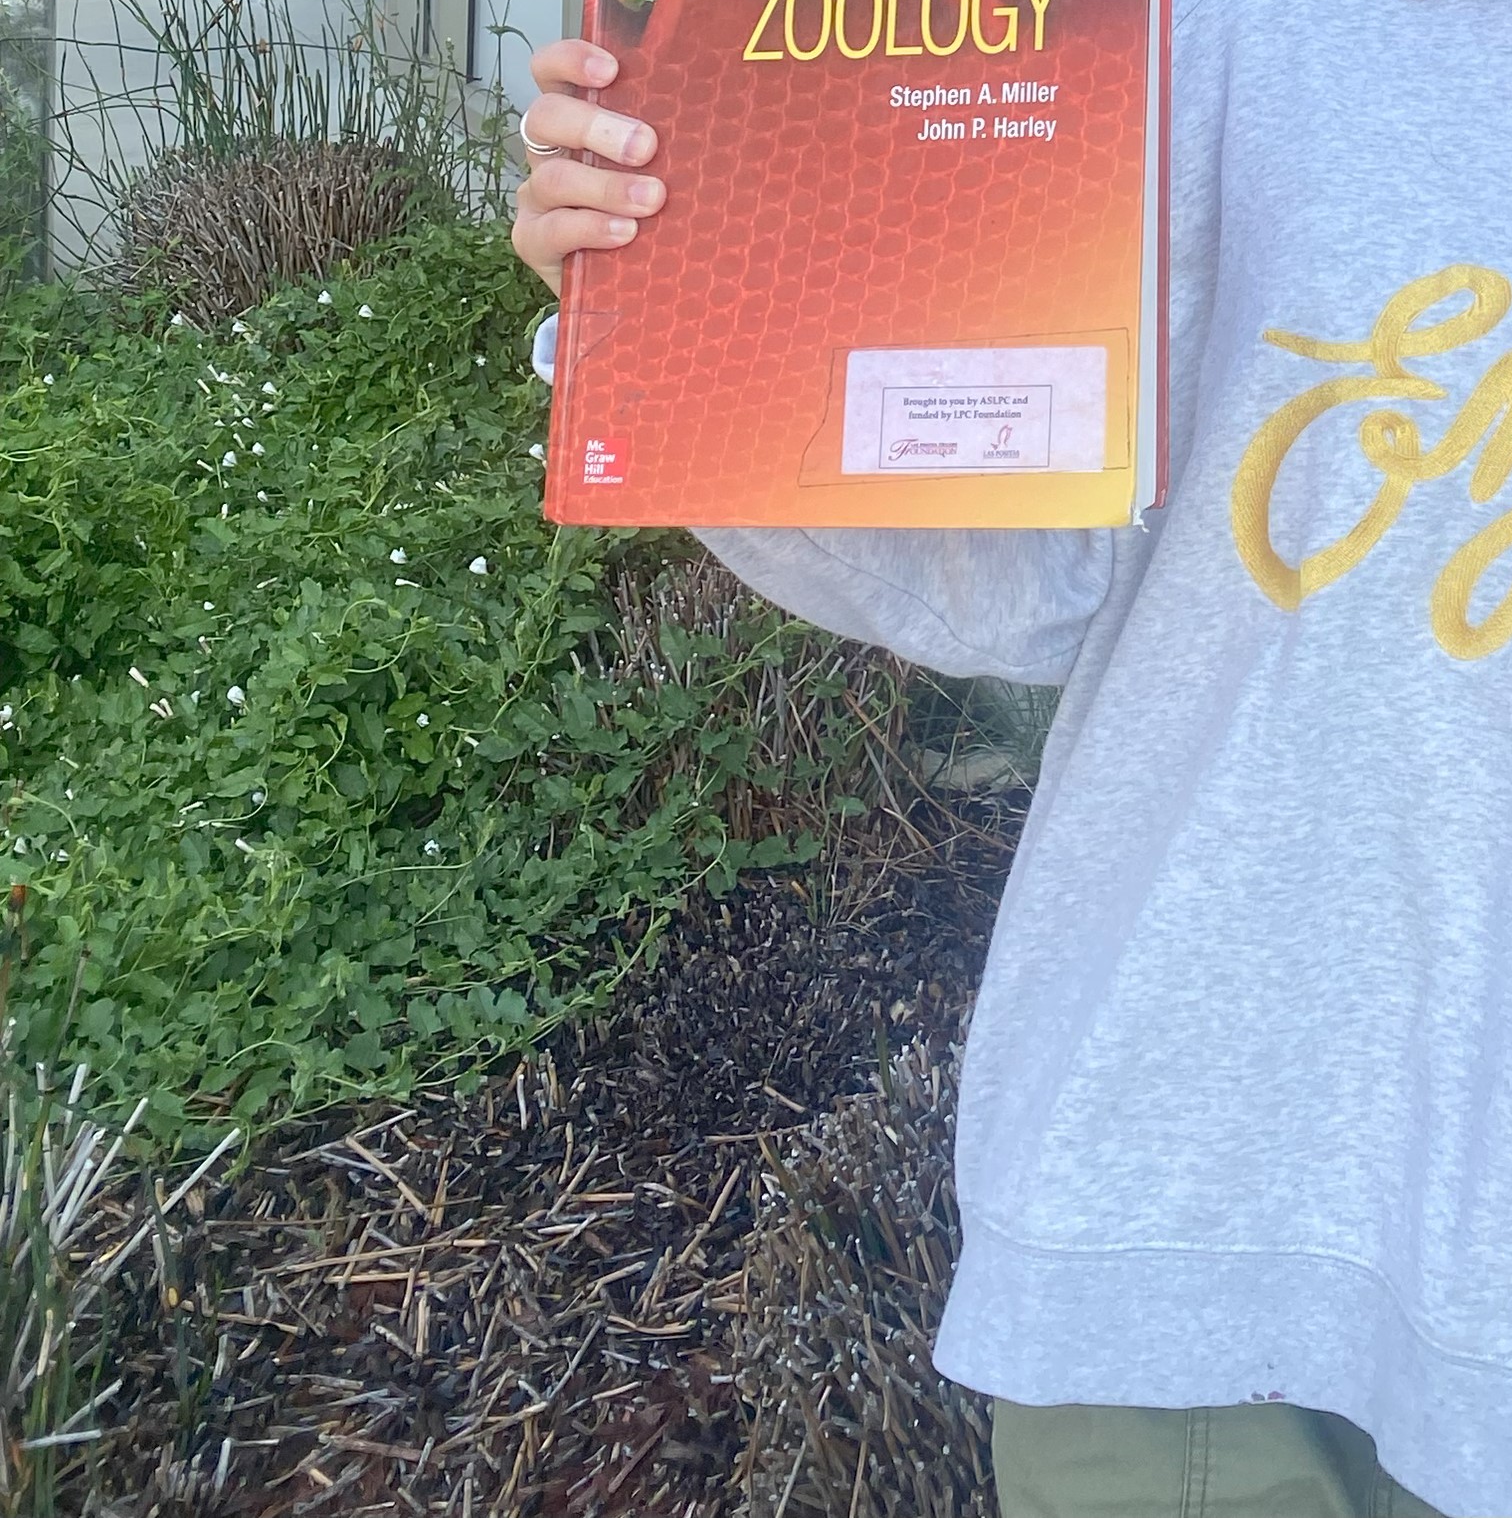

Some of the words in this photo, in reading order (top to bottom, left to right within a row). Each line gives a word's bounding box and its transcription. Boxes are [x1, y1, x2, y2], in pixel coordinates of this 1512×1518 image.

[889, 84, 971, 110] Stephen
[977, 83, 998, 105] A.
[1002, 81, 1059, 104] Miller
[917, 118, 965, 141] John
[971, 117, 987, 139] P.
[993, 115, 1057, 141] Harley
[903, 397, 937, 407] Brought
[938, 397, 947, 406] to
[949, 398, 965, 408] you
[967, 396, 977, 407] by
[979, 396, 1010, 406] ASLPC
[1012, 395, 1028, 405] and
[908, 410, 939, 420] funded
[941, 410, 952, 421] by
[954, 410, 971, 420] LPC
[973, 409, 1022, 420] Foundation
[586, 439, 605, 452] Mc
[585, 451, 616, 464] Graw
[584, 463, 604, 475] Hill
[583, 475, 624, 484] Education
